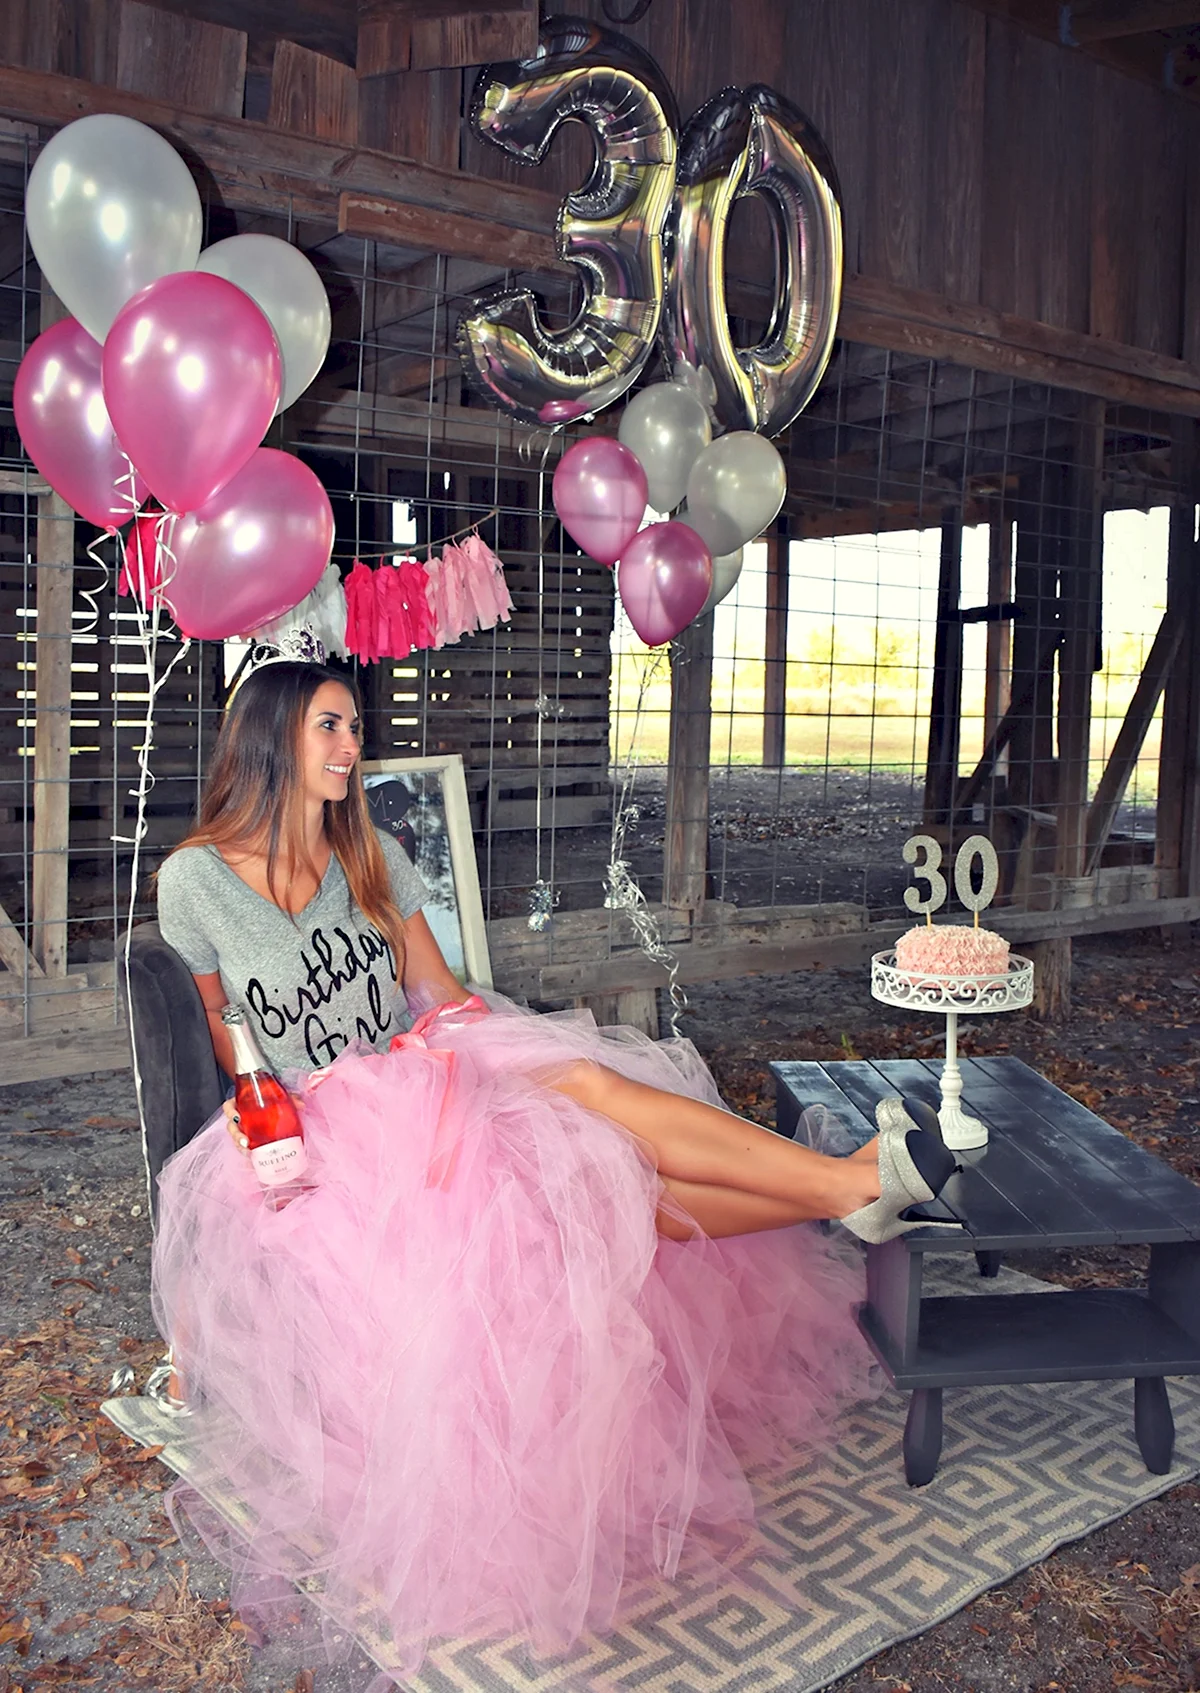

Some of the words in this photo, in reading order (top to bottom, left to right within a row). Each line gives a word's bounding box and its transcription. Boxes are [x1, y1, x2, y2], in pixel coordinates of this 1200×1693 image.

[457, 14, 842, 438] 30
[903, 834, 999, 914] 30
[245, 927, 397, 1039] Birthday
